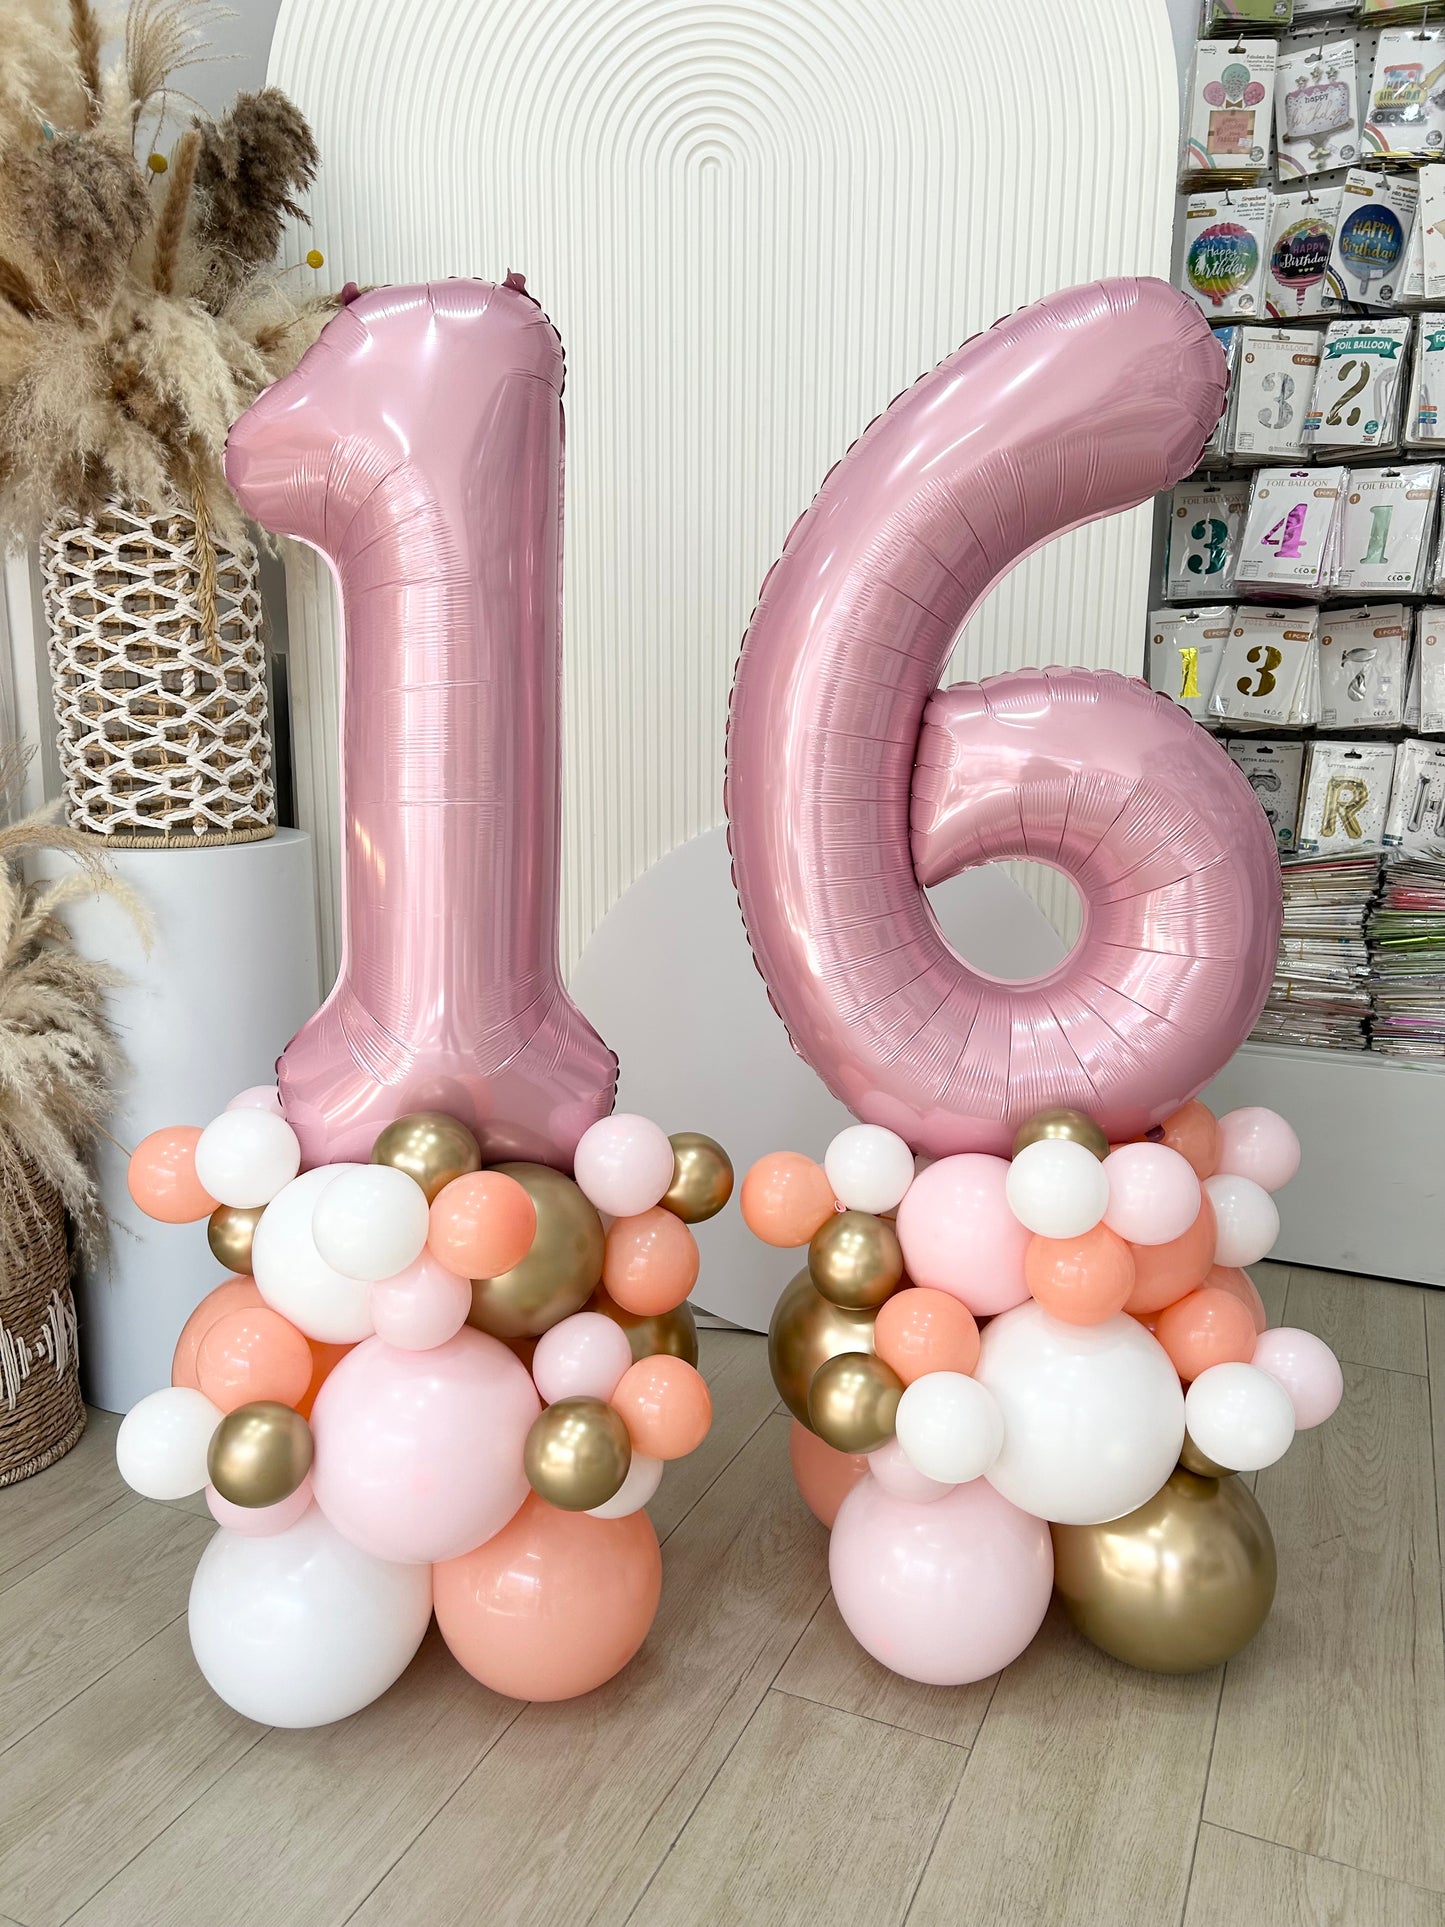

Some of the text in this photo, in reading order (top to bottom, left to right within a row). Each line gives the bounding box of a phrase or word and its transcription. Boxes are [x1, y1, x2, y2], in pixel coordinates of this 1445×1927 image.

[1304, 93, 1330, 104] happy
[1353, 219, 1395, 243] HAPPY
[1206, 244, 1238, 260] Happy
[1292, 242, 1325, 254] HAPPY
[1341, 236, 1396, 262] Birthday
[1194, 257, 1247, 279] Birthday
[1281, 253, 1330, 268] Birthday
[1335, 341, 1392, 350] FOIL BALLOON
[1357, 483, 1376, 491] FOIL
[1320, 775, 1368, 840] R
